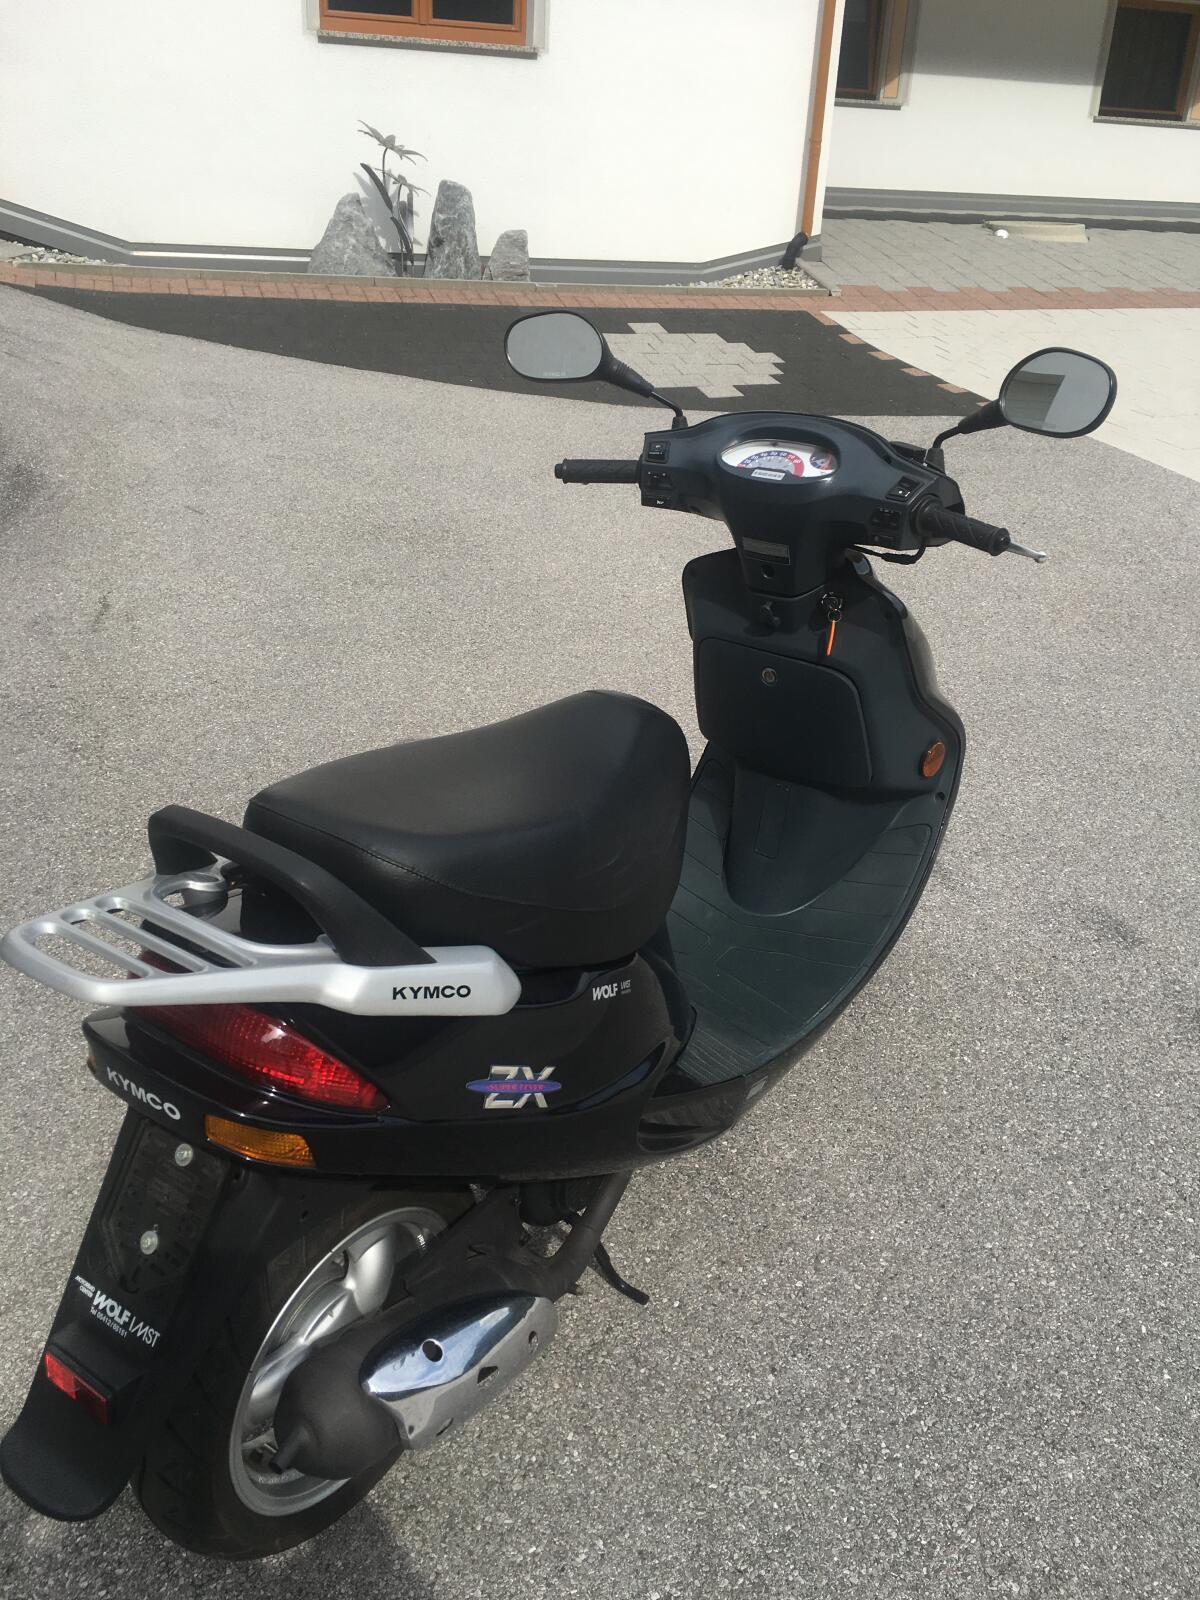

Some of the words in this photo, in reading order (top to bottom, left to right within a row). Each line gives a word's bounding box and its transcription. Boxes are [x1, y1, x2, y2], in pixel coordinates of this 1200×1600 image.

[392, 984, 472, 1000] KYMCO
[592, 983, 618, 1001] WOLF
[106, 1065, 182, 1121] KYMCO
[484, 1065, 556, 1109] ZX
[92, 1290, 132, 1326] WOLF
[128, 1316, 161, 1348] IMST
